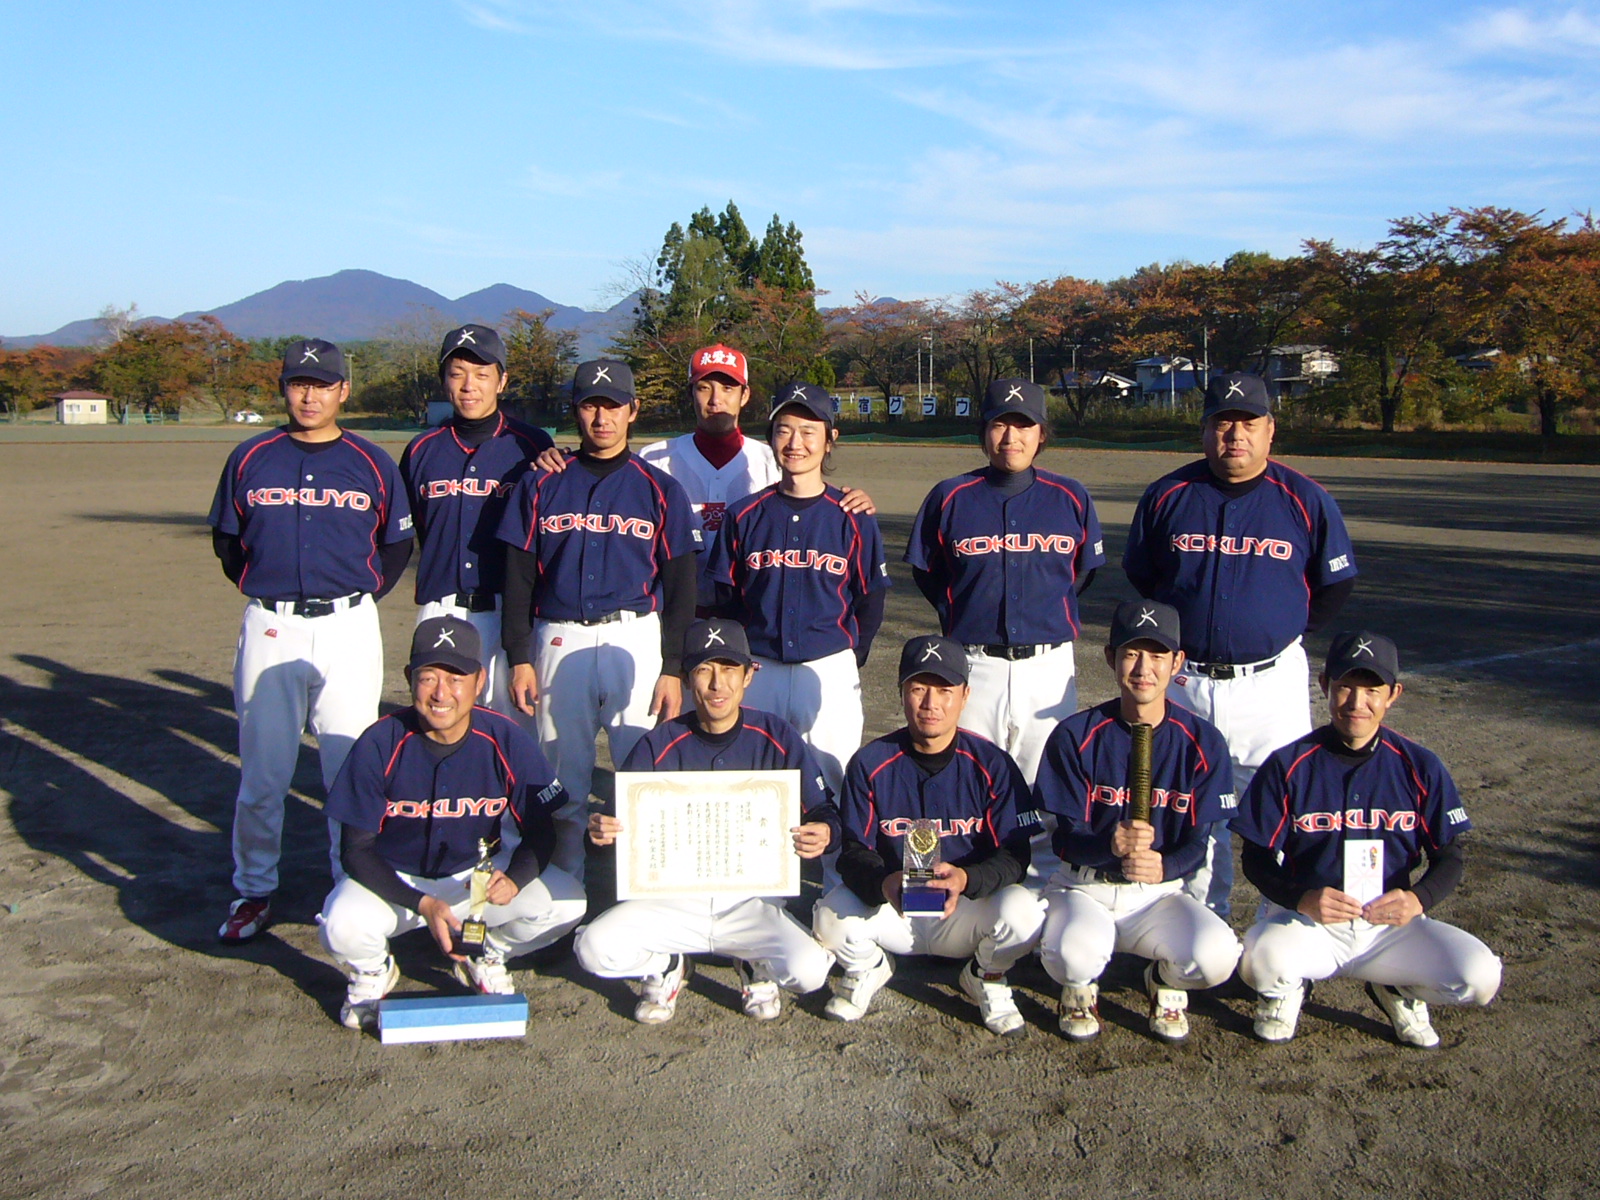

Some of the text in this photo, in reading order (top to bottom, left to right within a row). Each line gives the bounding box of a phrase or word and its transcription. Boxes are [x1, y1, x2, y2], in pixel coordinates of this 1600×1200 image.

[247, 488, 371, 511] KOKUYO
[420, 478, 517, 499] KOKUY
[539, 513, 655, 540] KOKUYO
[952, 533, 1075, 557] KOKUYO
[1170, 533, 1293, 561] KOKUYO
[746, 549, 848, 576] KOKUYO
[1292, 809, 1420, 832] KOKUYO
